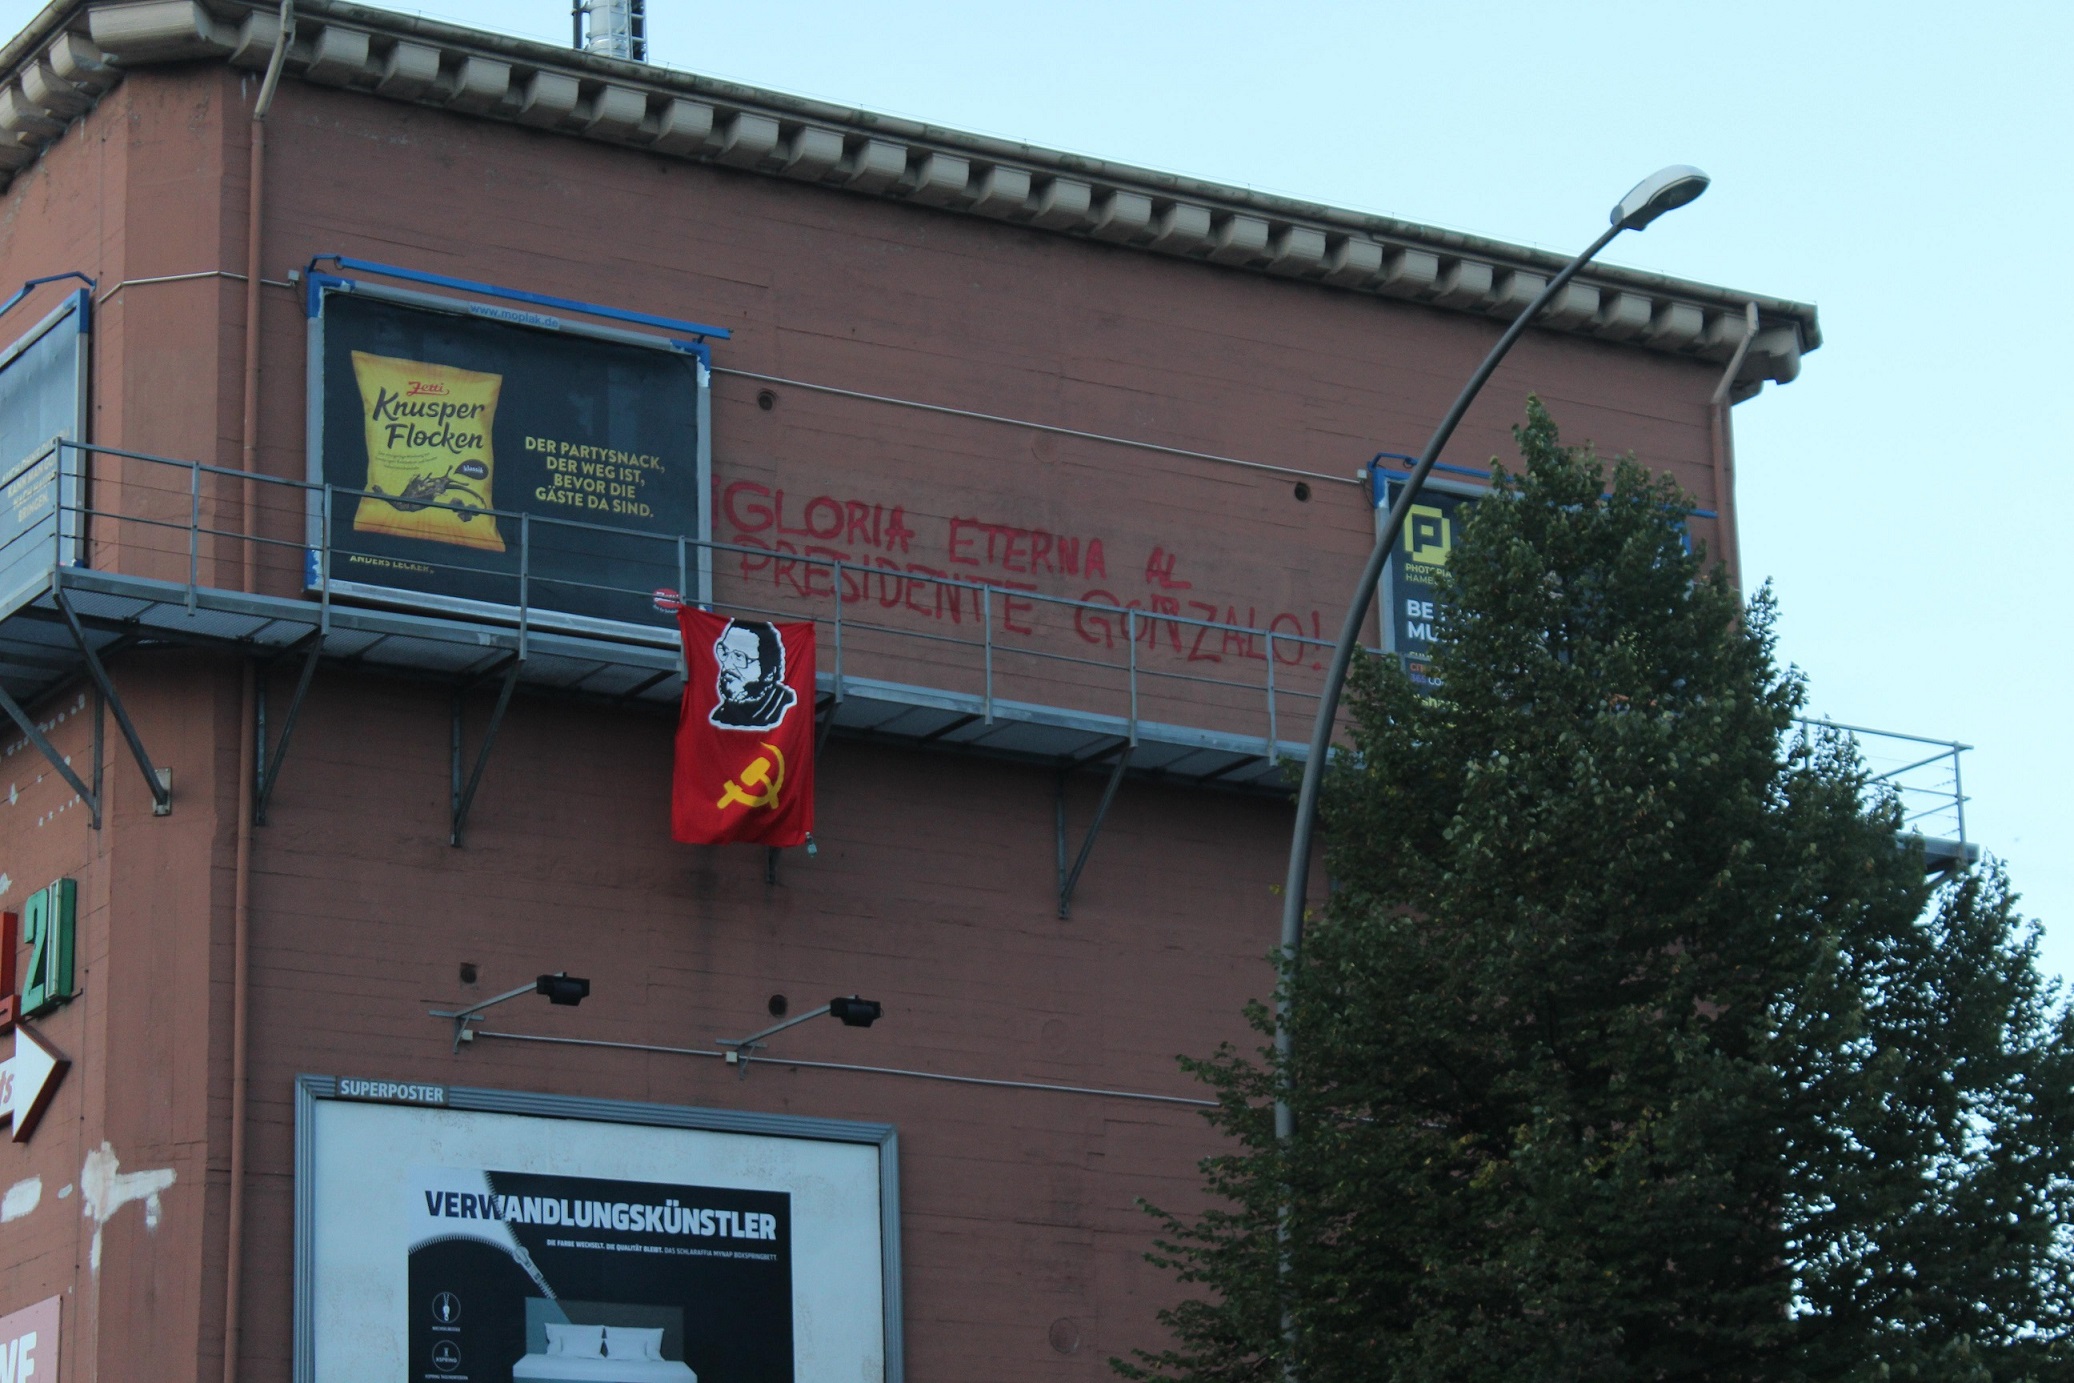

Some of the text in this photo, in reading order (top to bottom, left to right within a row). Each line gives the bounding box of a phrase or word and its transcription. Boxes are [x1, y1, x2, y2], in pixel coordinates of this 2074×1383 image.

[470, 304, 560, 328] www.moplak.de
[406, 381, 450, 397] Zetti
[373, 386, 486, 427] Knusper
[385, 422, 485, 455] Flocken
[525, 436, 666, 474] DER PARTYSNACK,
[546, 456, 646, 487] DER WEG IST,
[553, 473, 636, 499] BEVOR DIE
[535, 485, 655, 518] GÄSTE DA SIND.
[950, 515, 1107, 581] ETERNA
[1146, 547, 1193, 590] AL
[733, 534, 1038, 636] PRESIDENTE
[1406, 599, 1435, 620] BE
[340, 1079, 444, 1102] SUPERPOSTER
[424, 1189, 777, 1242] VERWANDLUNGSKÜNSTLER
[616, 1243, 642, 1252] QUALITÄT
[664, 1246, 676, 1255] DAS
